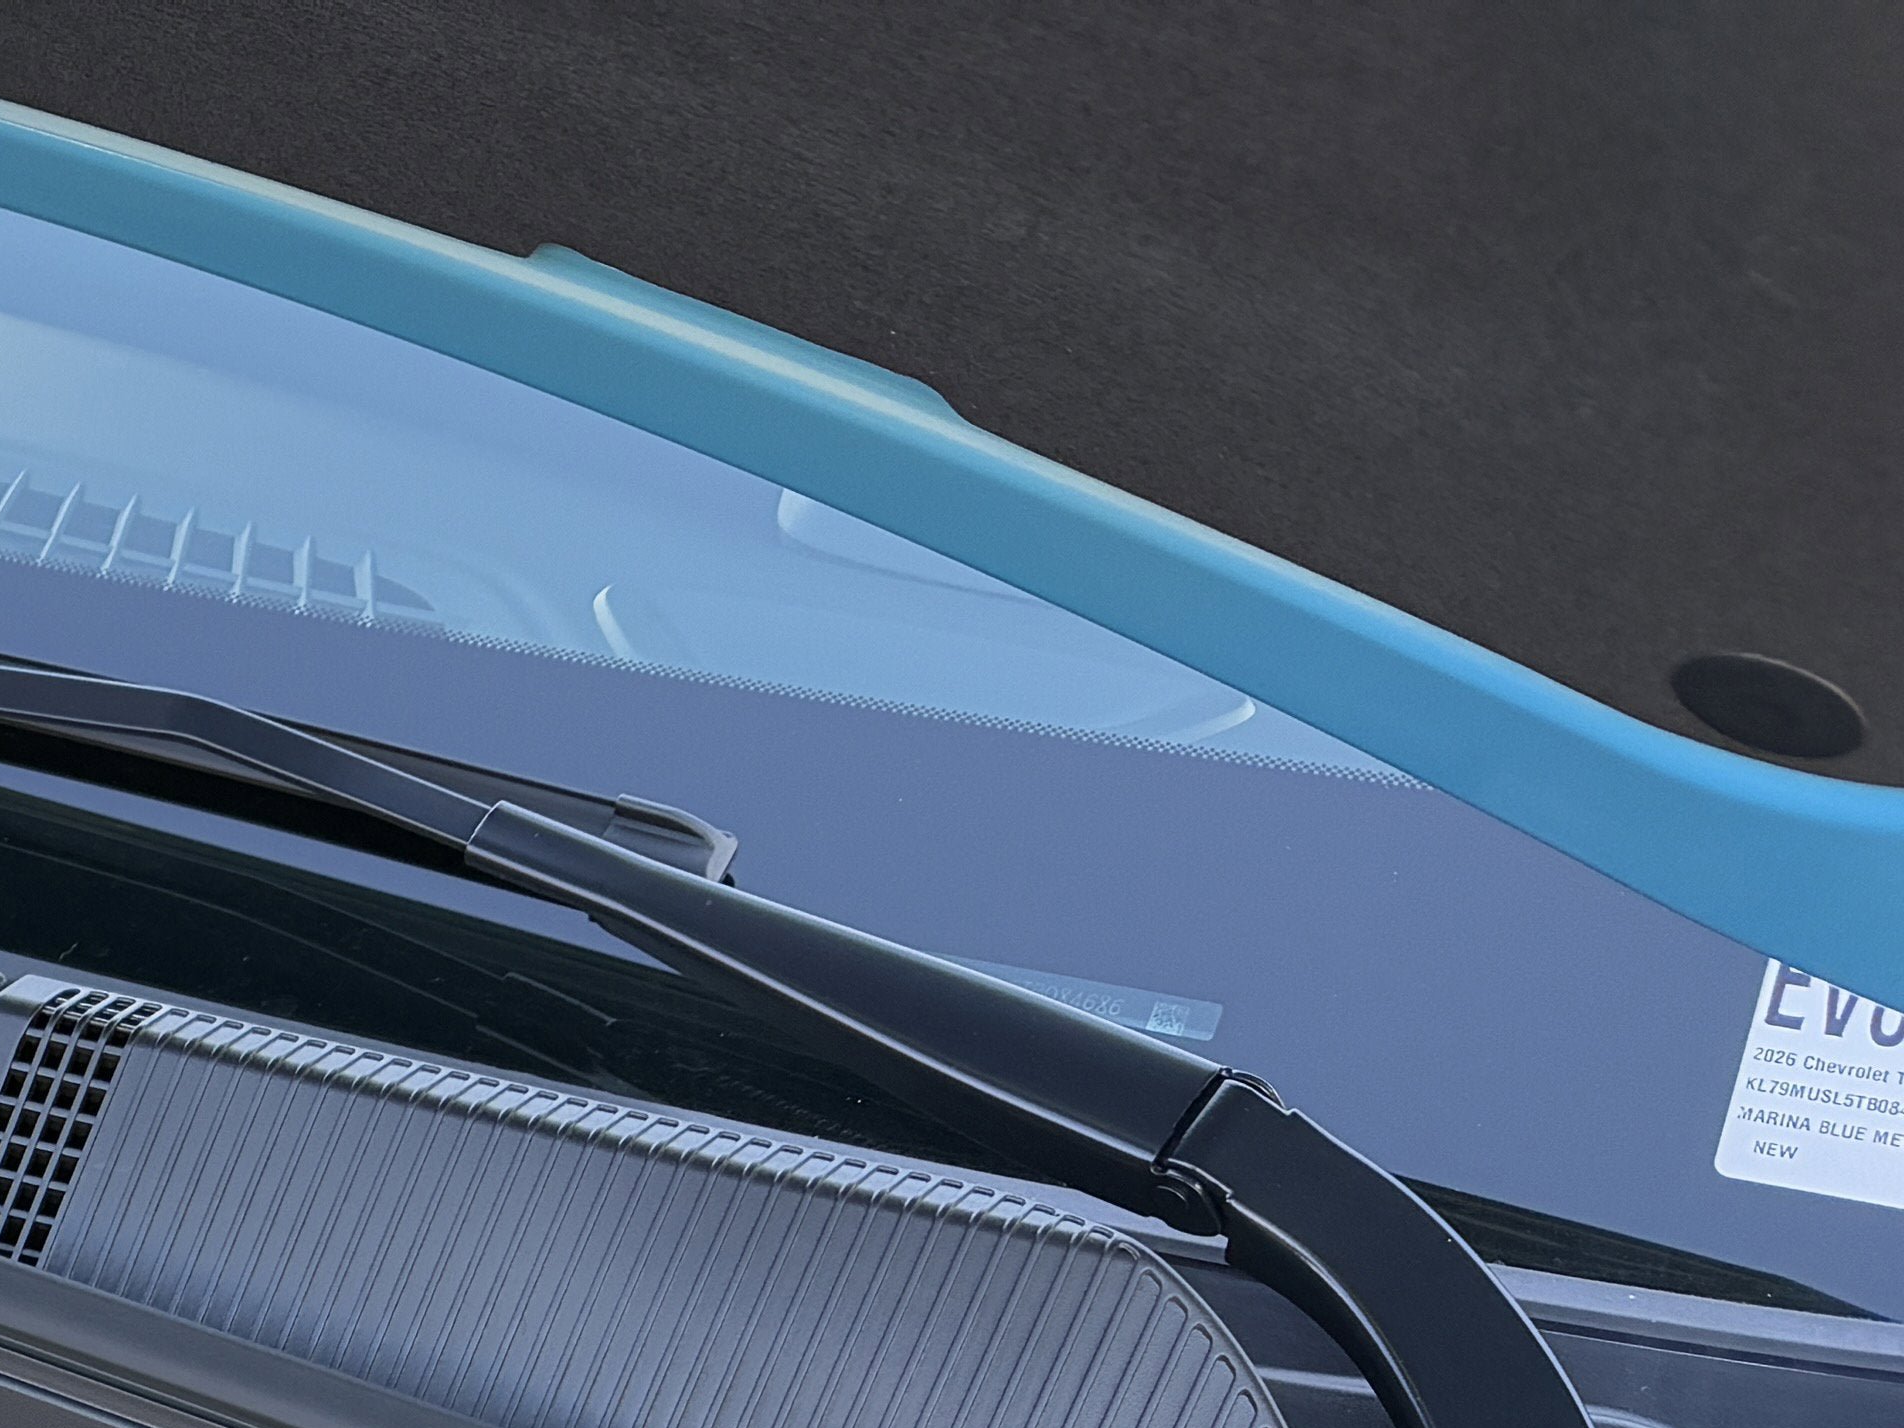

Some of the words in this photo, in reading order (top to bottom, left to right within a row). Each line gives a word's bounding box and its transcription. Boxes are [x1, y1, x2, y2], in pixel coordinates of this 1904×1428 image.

[1753, 1046, 1796, 1067] 2026
[1803, 1055, 1890, 1084] Chevrolet
[1737, 1105, 1811, 1132] MARINA
[1819, 1120, 1868, 1141] BLUE
[1753, 1140, 1799, 1160] NEW
